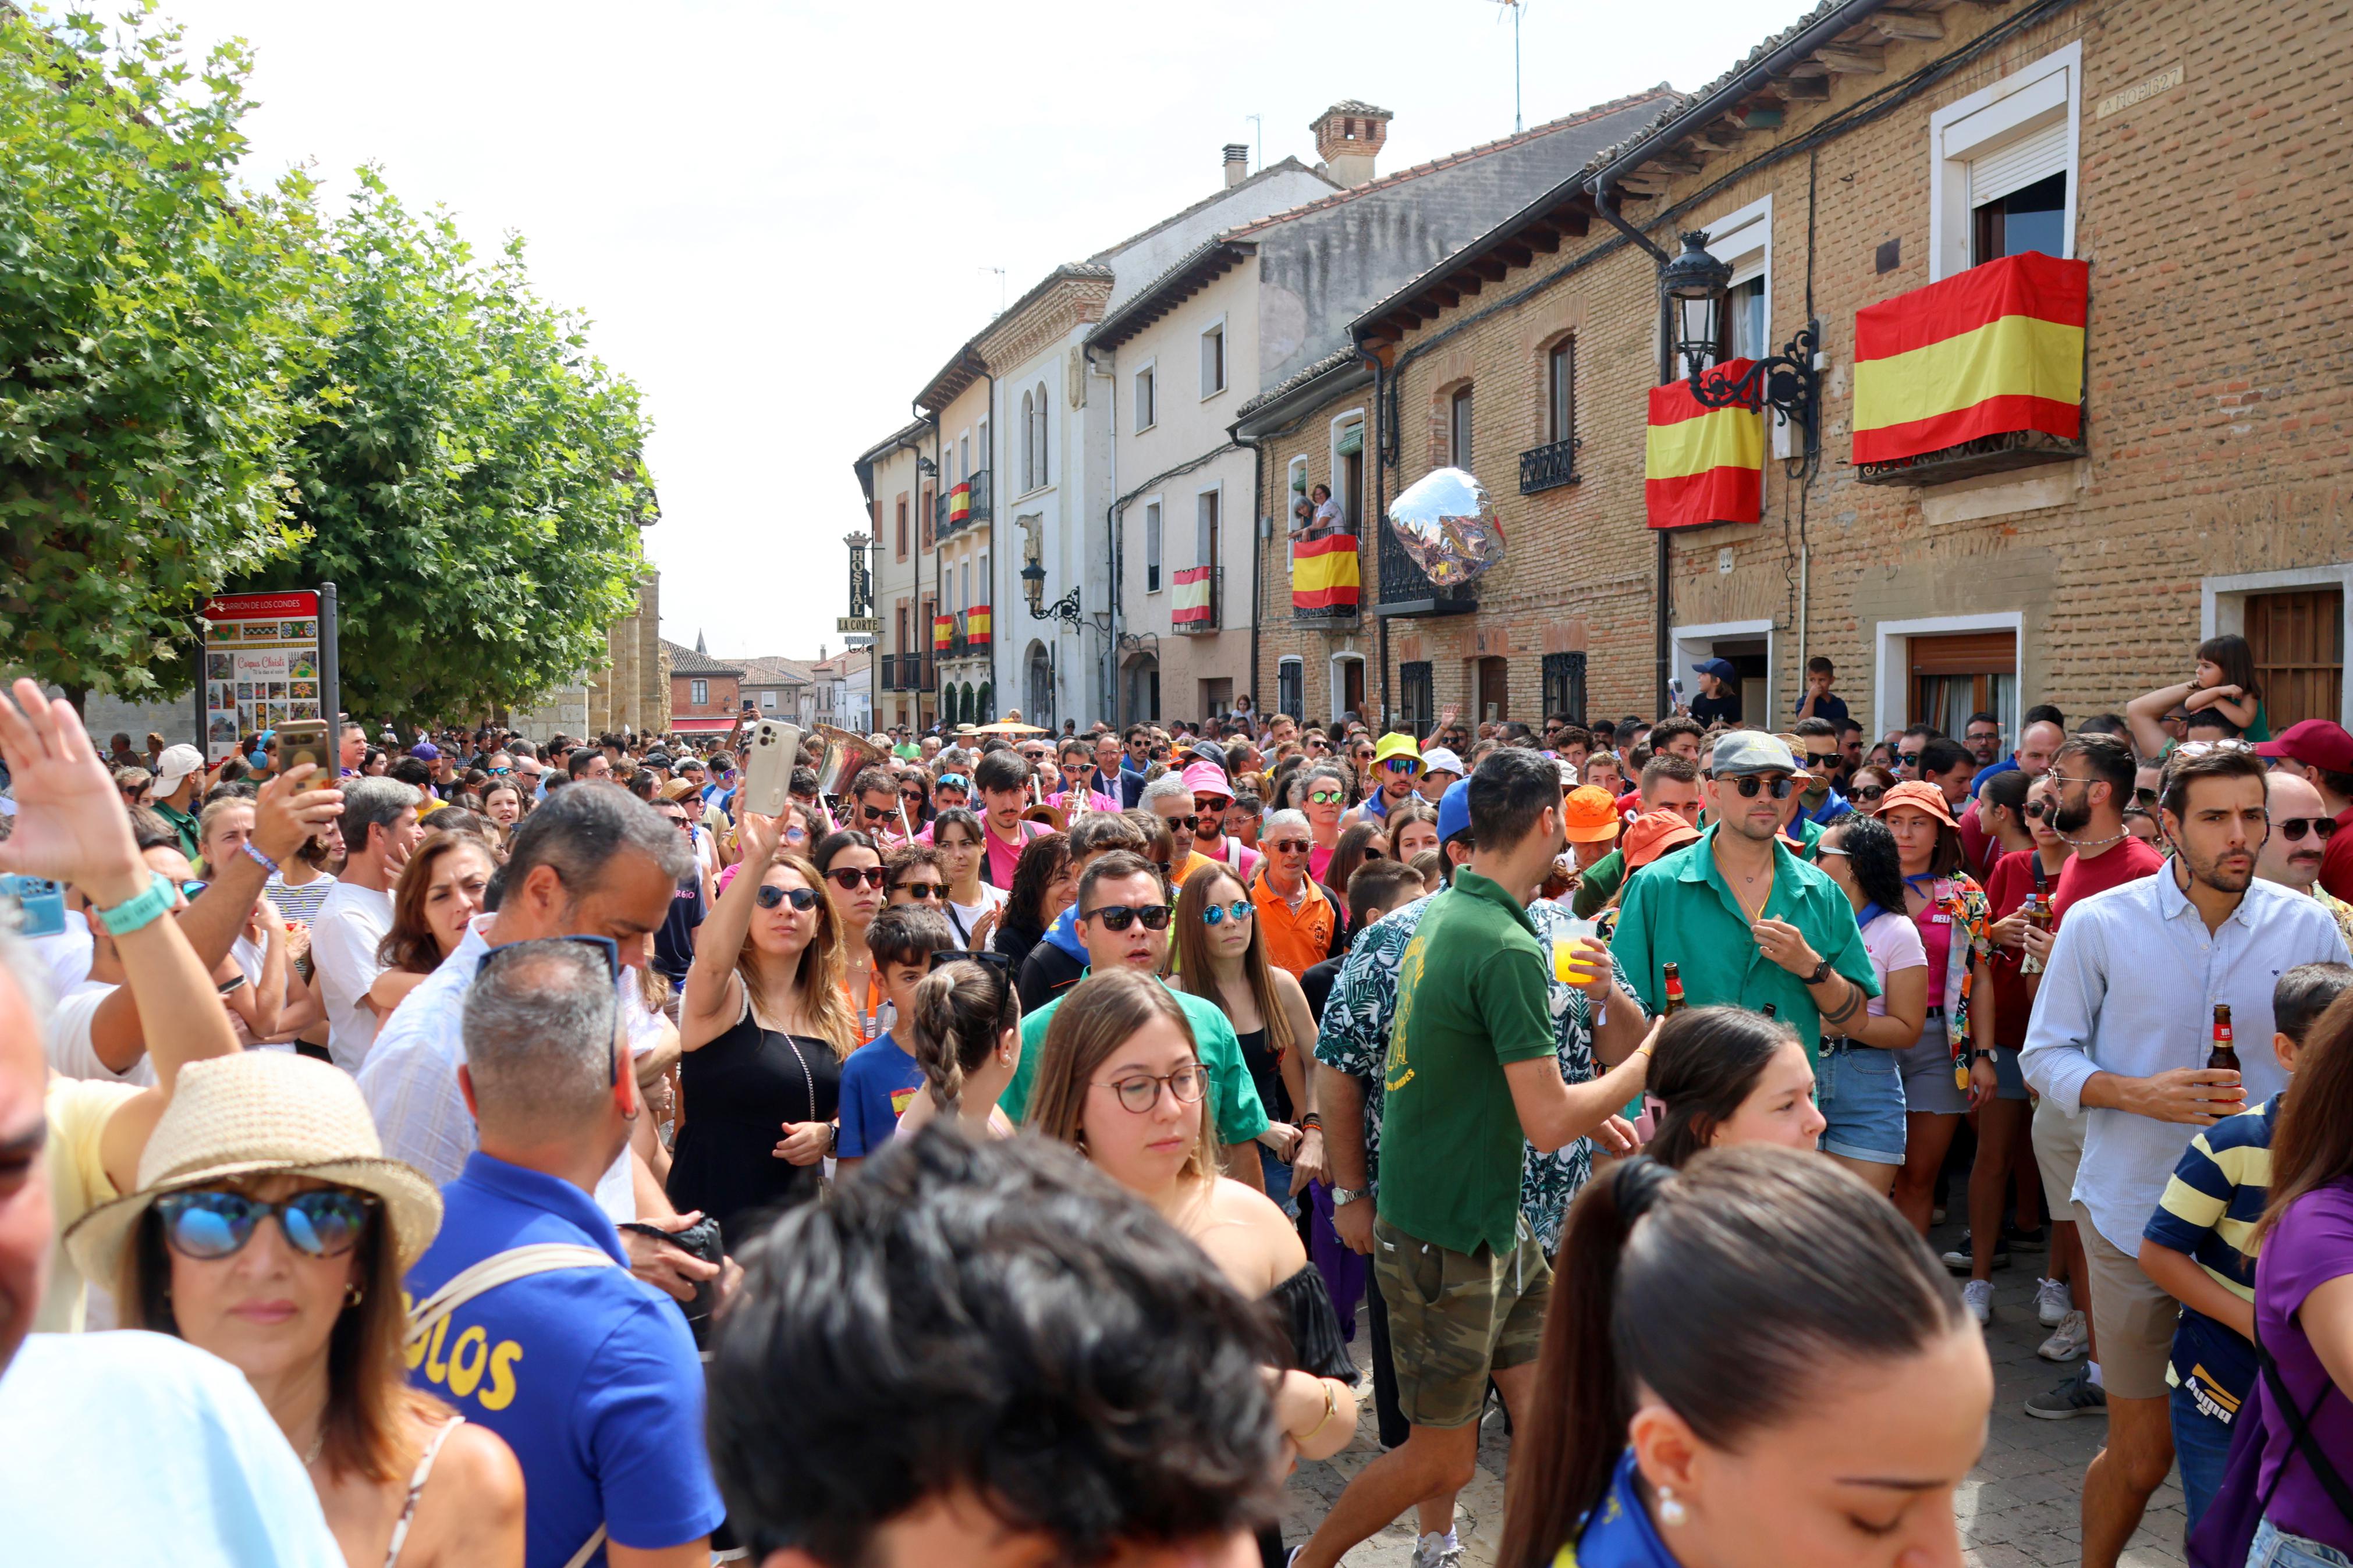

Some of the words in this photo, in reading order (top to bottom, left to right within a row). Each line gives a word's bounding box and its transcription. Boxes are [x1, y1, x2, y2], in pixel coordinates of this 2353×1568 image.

[851, 550, 864, 615] HOSTAL
[223, 601, 250, 610] ARRIÓN
[251, 601, 260, 609] DE
[260, 600, 272, 609] LOS
[273, 599, 300, 607] CONDES
[839, 620, 849, 630] LA
[851, 620, 878, 630] CORTE
[237, 656, 261, 670] Corpus
[262, 656, 285, 669] Christi
[2185, 1376, 2232, 1424] PUMA
